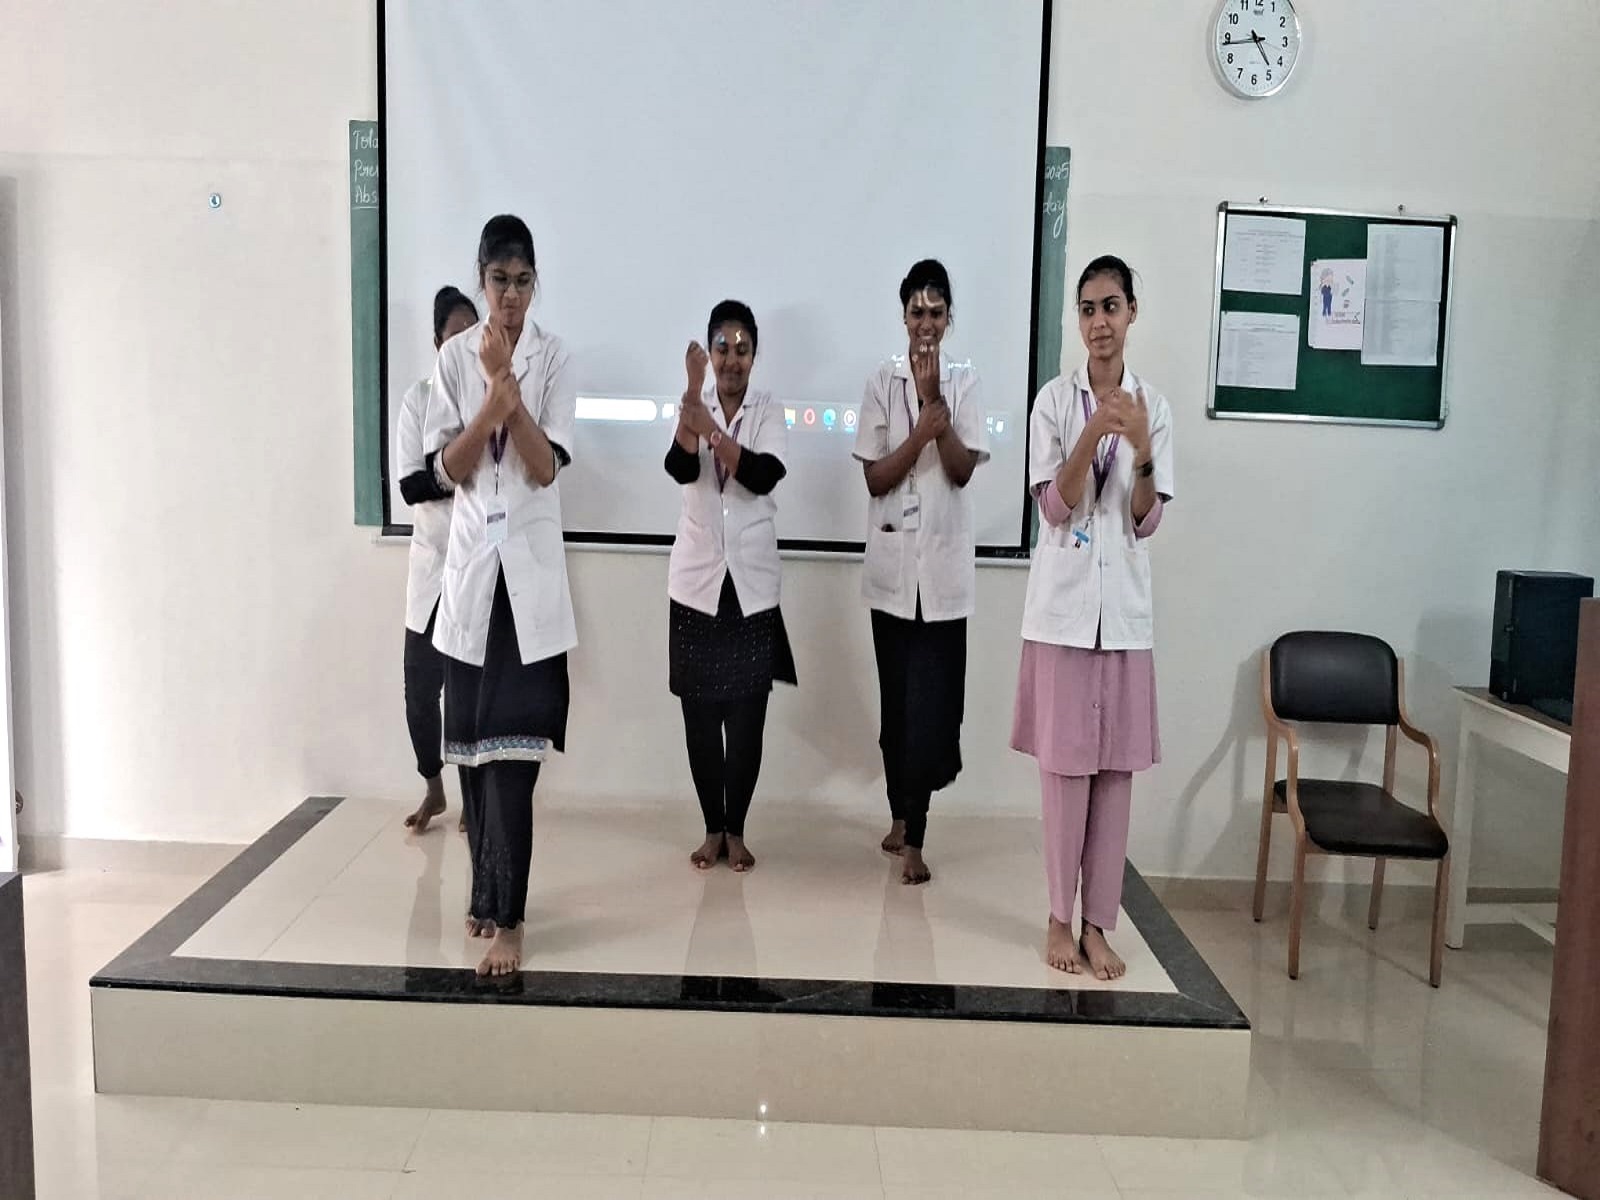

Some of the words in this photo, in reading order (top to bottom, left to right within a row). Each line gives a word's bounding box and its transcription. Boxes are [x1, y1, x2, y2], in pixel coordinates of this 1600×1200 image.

[1229, 13, 1239, 25] 10
[1279, 16, 1286, 28] 2
[1224, 32, 1231, 44] 9
[1282, 36, 1288, 47] 3
[1227, 53, 1234, 64] 8
[1277, 56, 1283, 67] 4
[1237, 68, 1243, 79] 7
[1266, 69, 1272, 81] 5
[1251, 74, 1257, 85] 6
